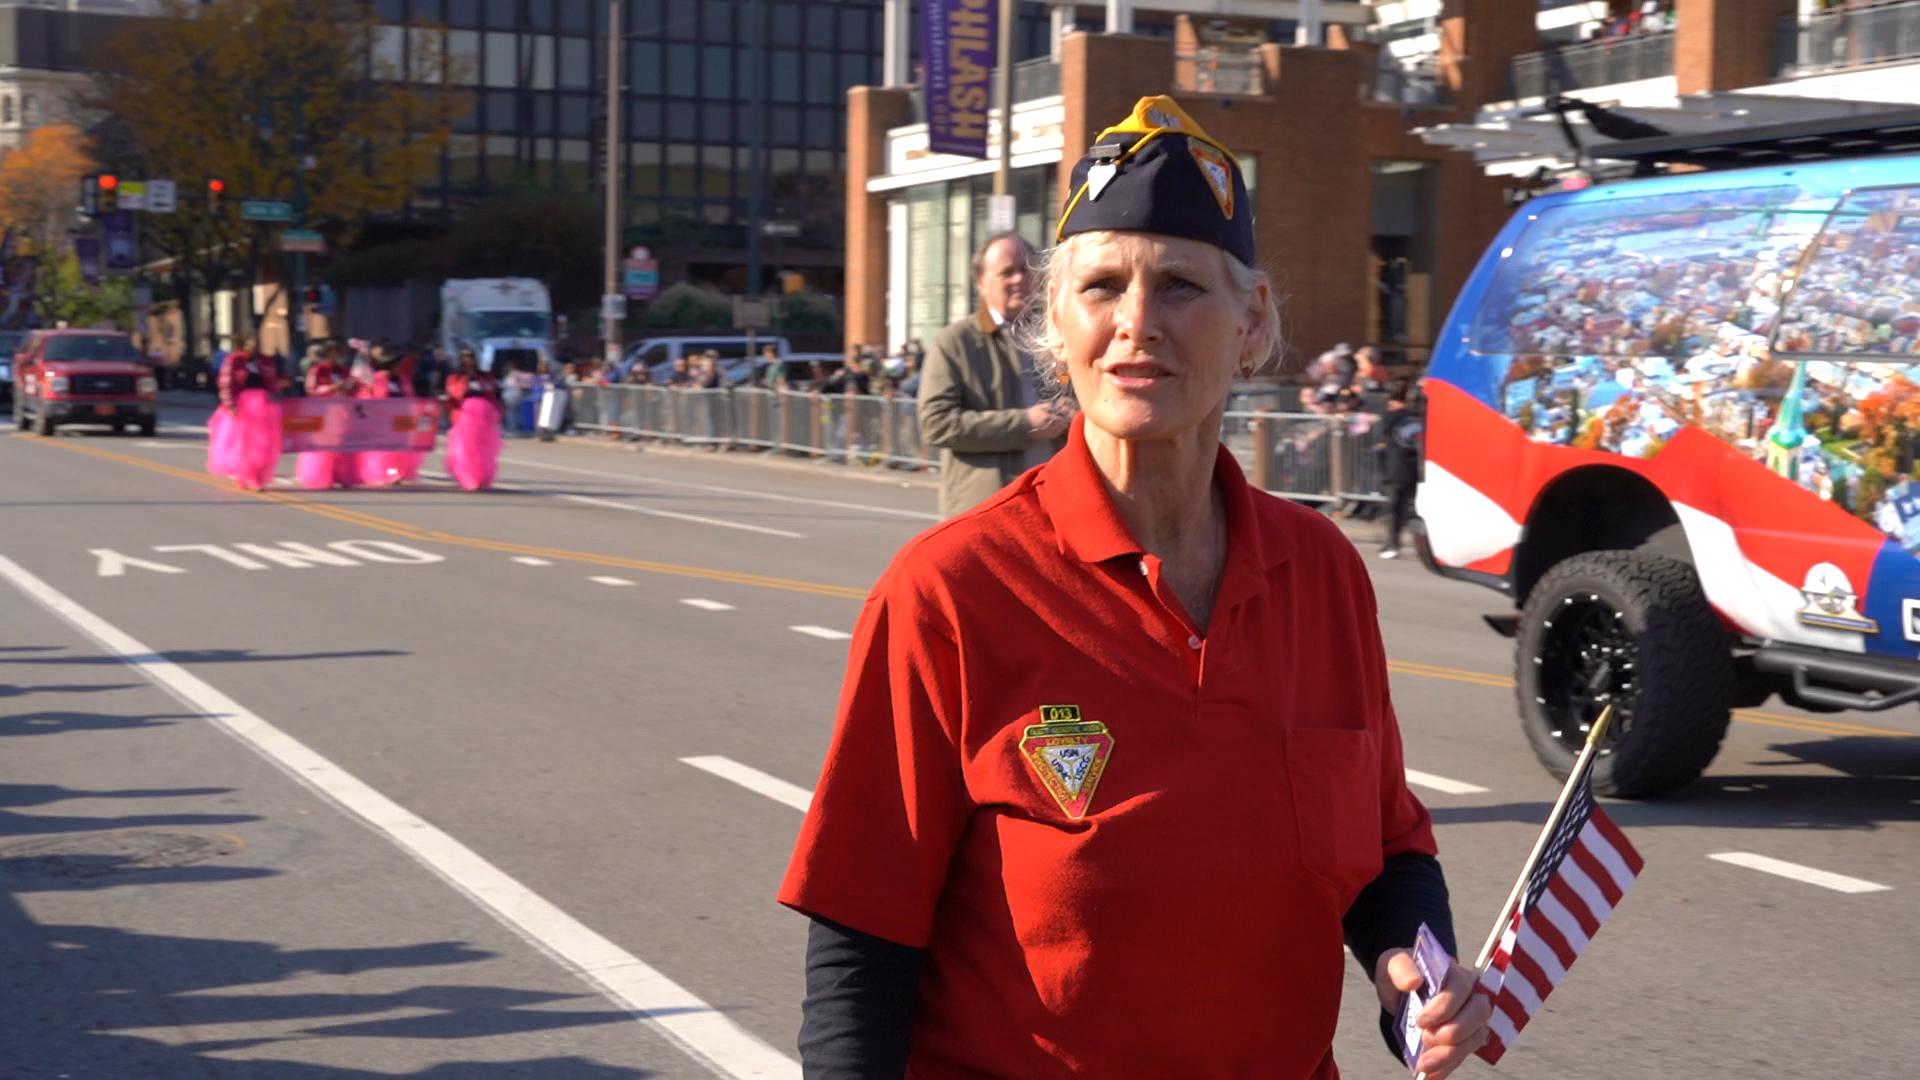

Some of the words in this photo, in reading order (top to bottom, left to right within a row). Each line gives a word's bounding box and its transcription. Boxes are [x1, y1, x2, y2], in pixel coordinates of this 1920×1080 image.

[928, 0, 946, 89] wntown
[88, 539, 446, 577] ONLY
[1049, 707, 1073, 721] 013
[1059, 748, 1079, 758] USN
